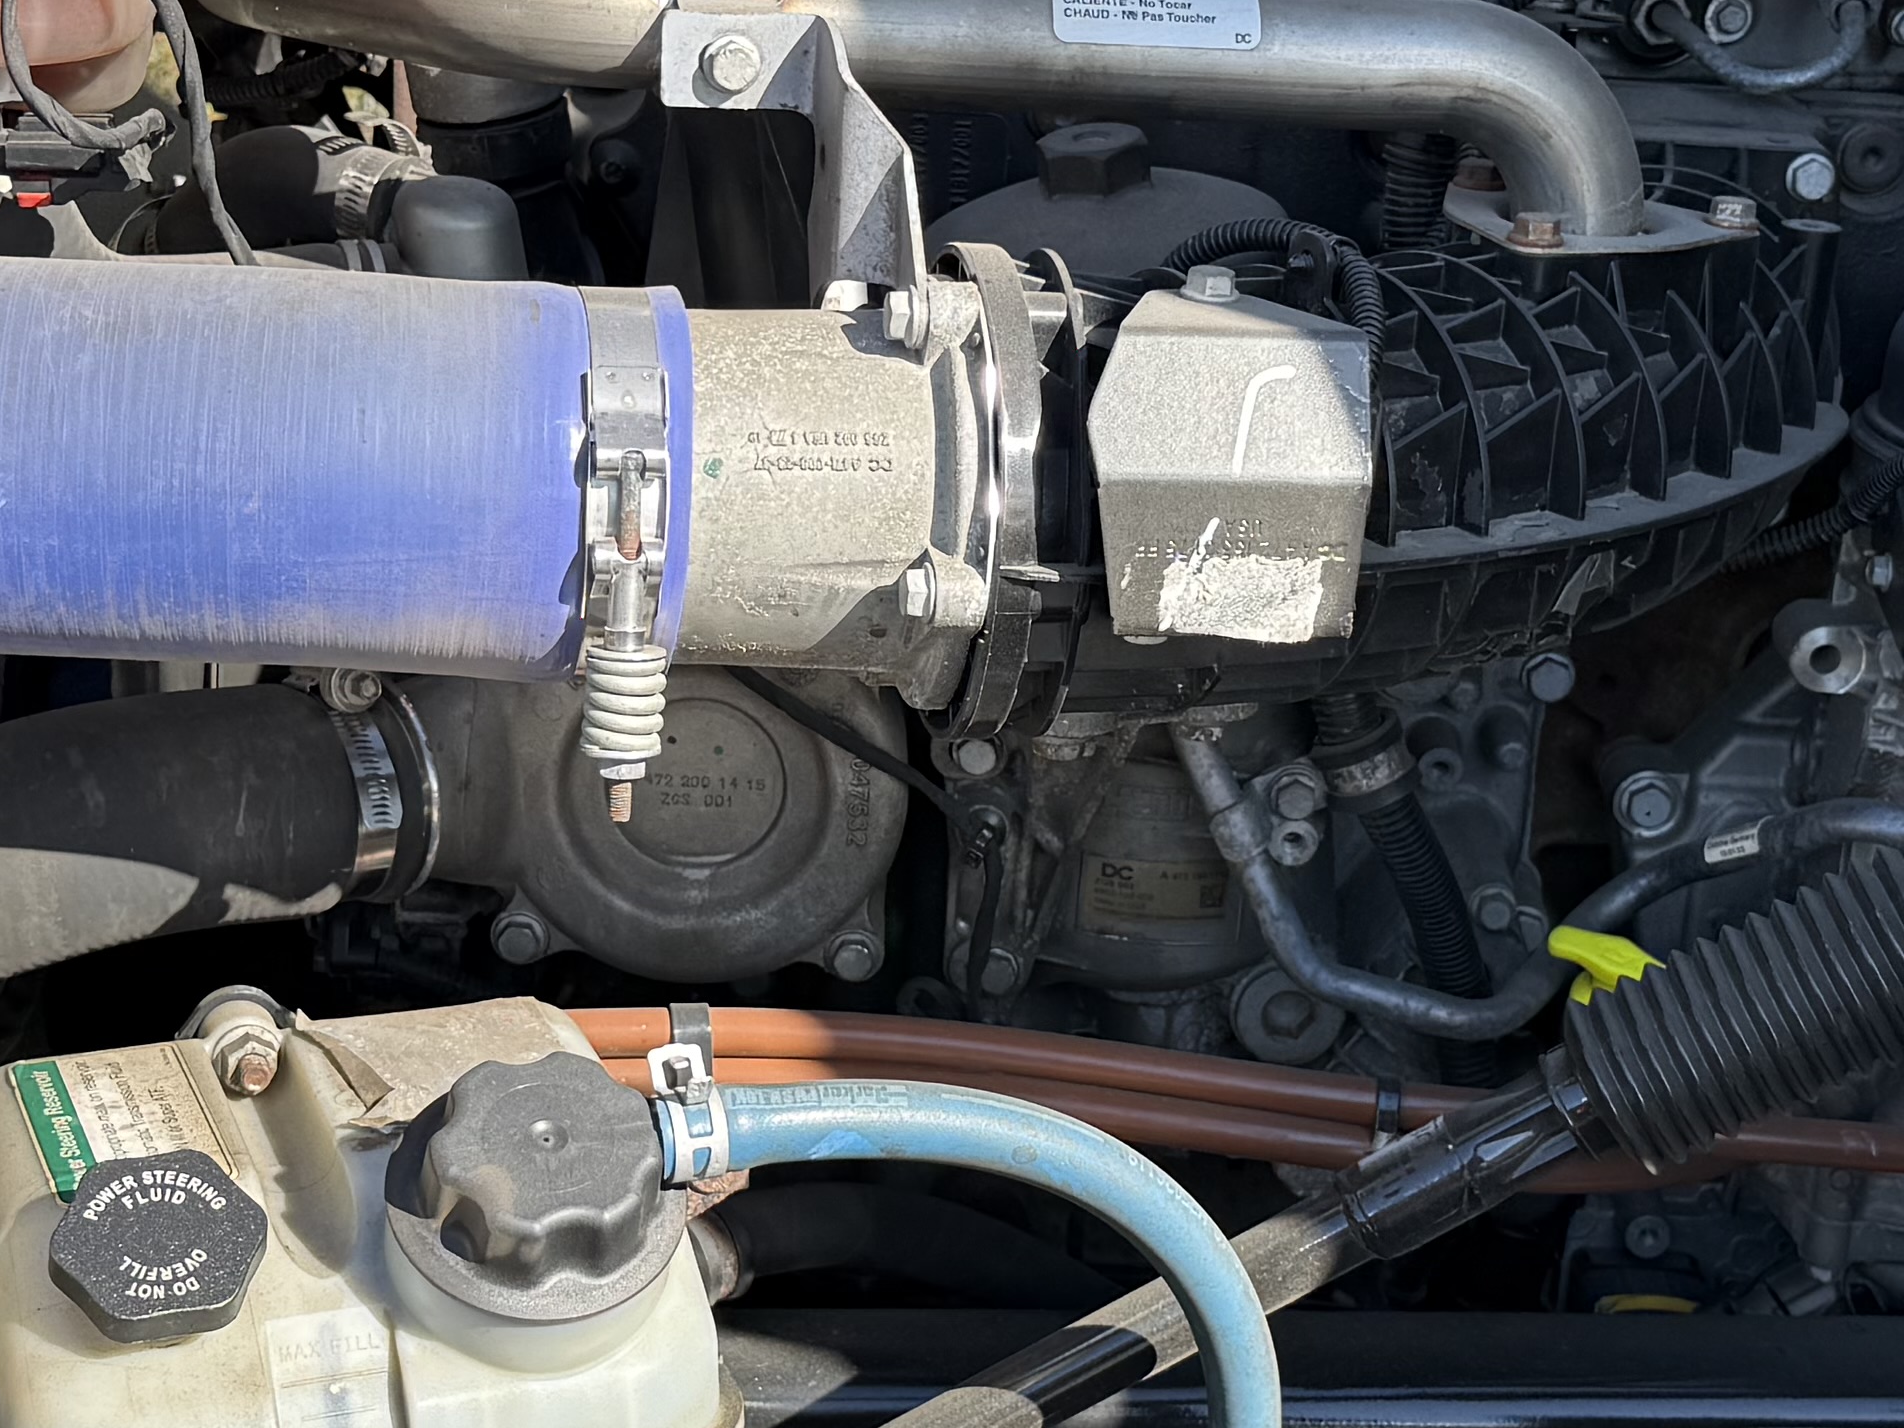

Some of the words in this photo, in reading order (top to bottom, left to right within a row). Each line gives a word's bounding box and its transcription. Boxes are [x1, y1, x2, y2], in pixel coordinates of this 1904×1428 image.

[1139, 0, 1155, 8] No
[1159, 0, 1192, 11] Tocar
[1063, 8, 1109, 20] CHAUD
[1142, 11, 1164, 22] Pas
[1167, 13, 1216, 24] Toucher
[1235, 33, 1252, 44] DC
[680, 775, 711, 788] 200
[720, 777, 738, 789] 14
[704, 794, 733, 807] 001
[1101, 862, 1134, 881] DC
[32, 1070, 64, 1116] Reservoir
[51, 1115, 80, 1158] Steering
[83, 1174, 138, 1221] POWER
[141, 1170, 227, 1210] STEERING
[121, 1187, 186, 1210] FLUID
[119, 1248, 208, 1281] OVERFILL
[125, 1282, 165, 1300] NOT
[173, 1277, 200, 1296] DO
[279, 1341, 321, 1363] MAX
[330, 1333, 381, 1351] FILL
